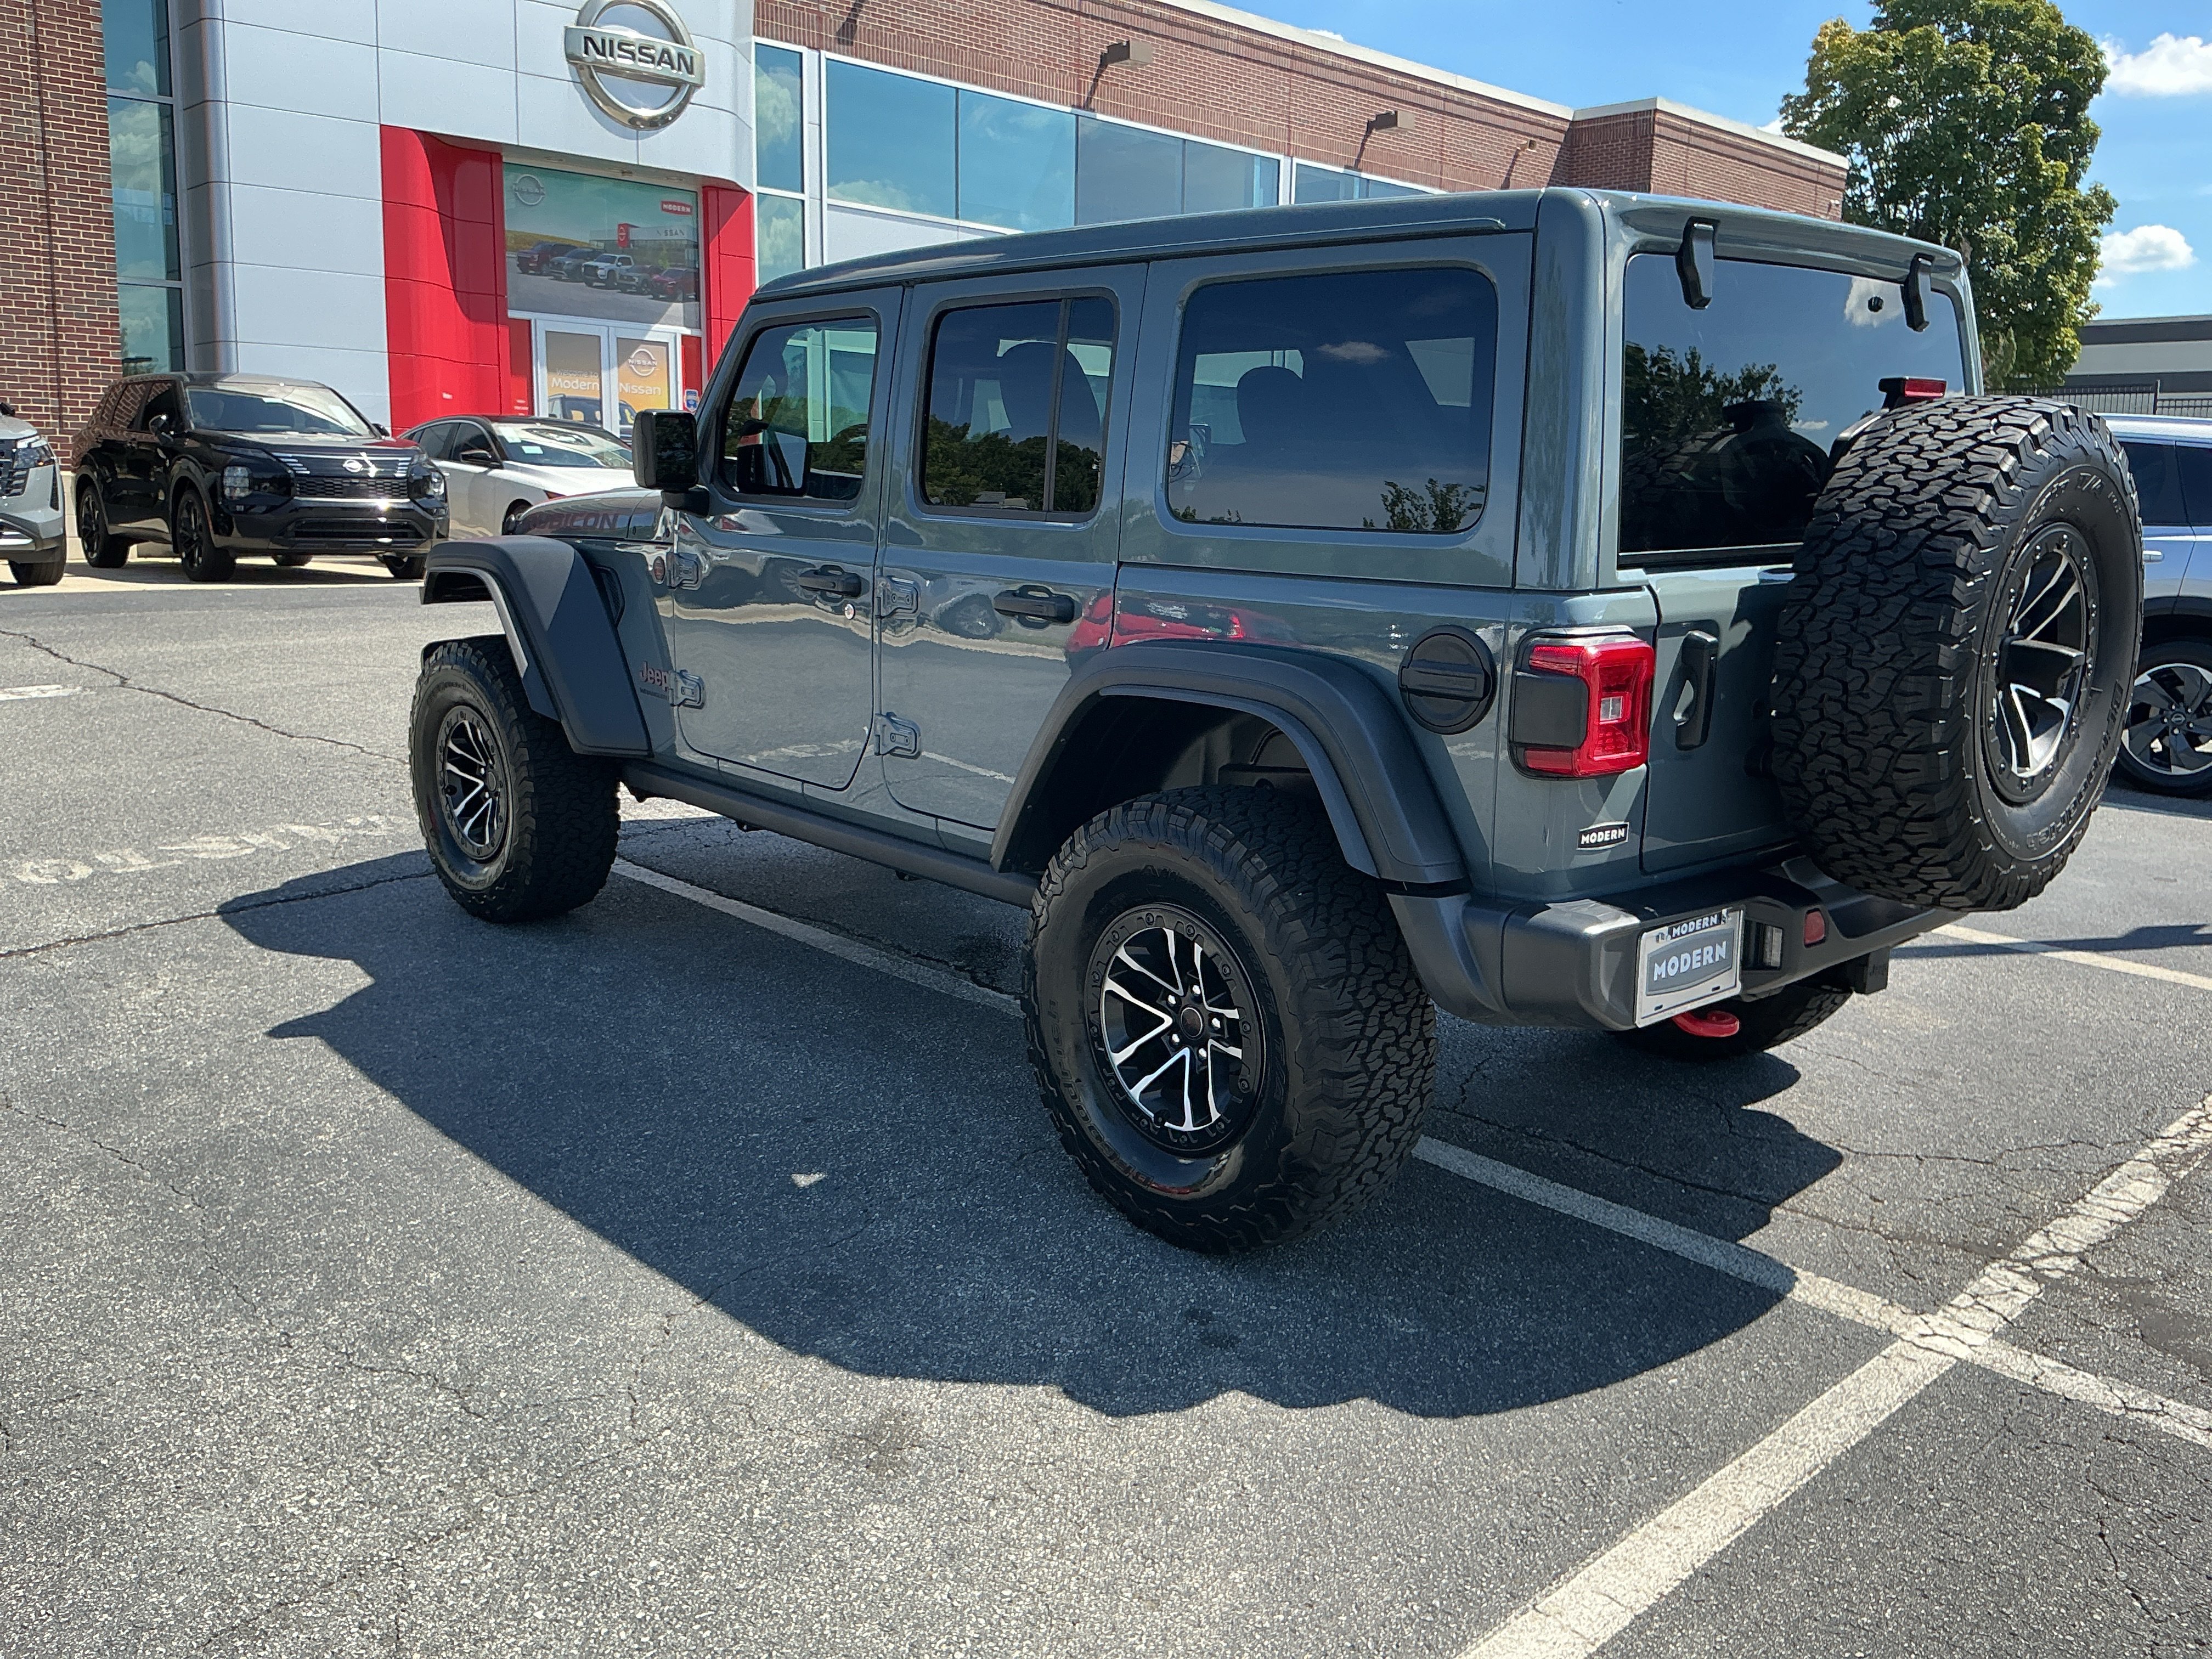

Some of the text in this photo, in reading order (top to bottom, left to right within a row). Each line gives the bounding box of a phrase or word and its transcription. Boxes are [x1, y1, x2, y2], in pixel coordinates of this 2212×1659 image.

[583, 35, 695, 77] NISSAN
[663, 204, 691, 212] MODERN
[551, 377, 662, 396] Modern Nissan
[639, 661, 669, 692] Jeep
[1581, 827, 1625, 845] MODERN
[1672, 914, 1718, 938] MODERN
[1654, 940, 1727, 981] MODERN
